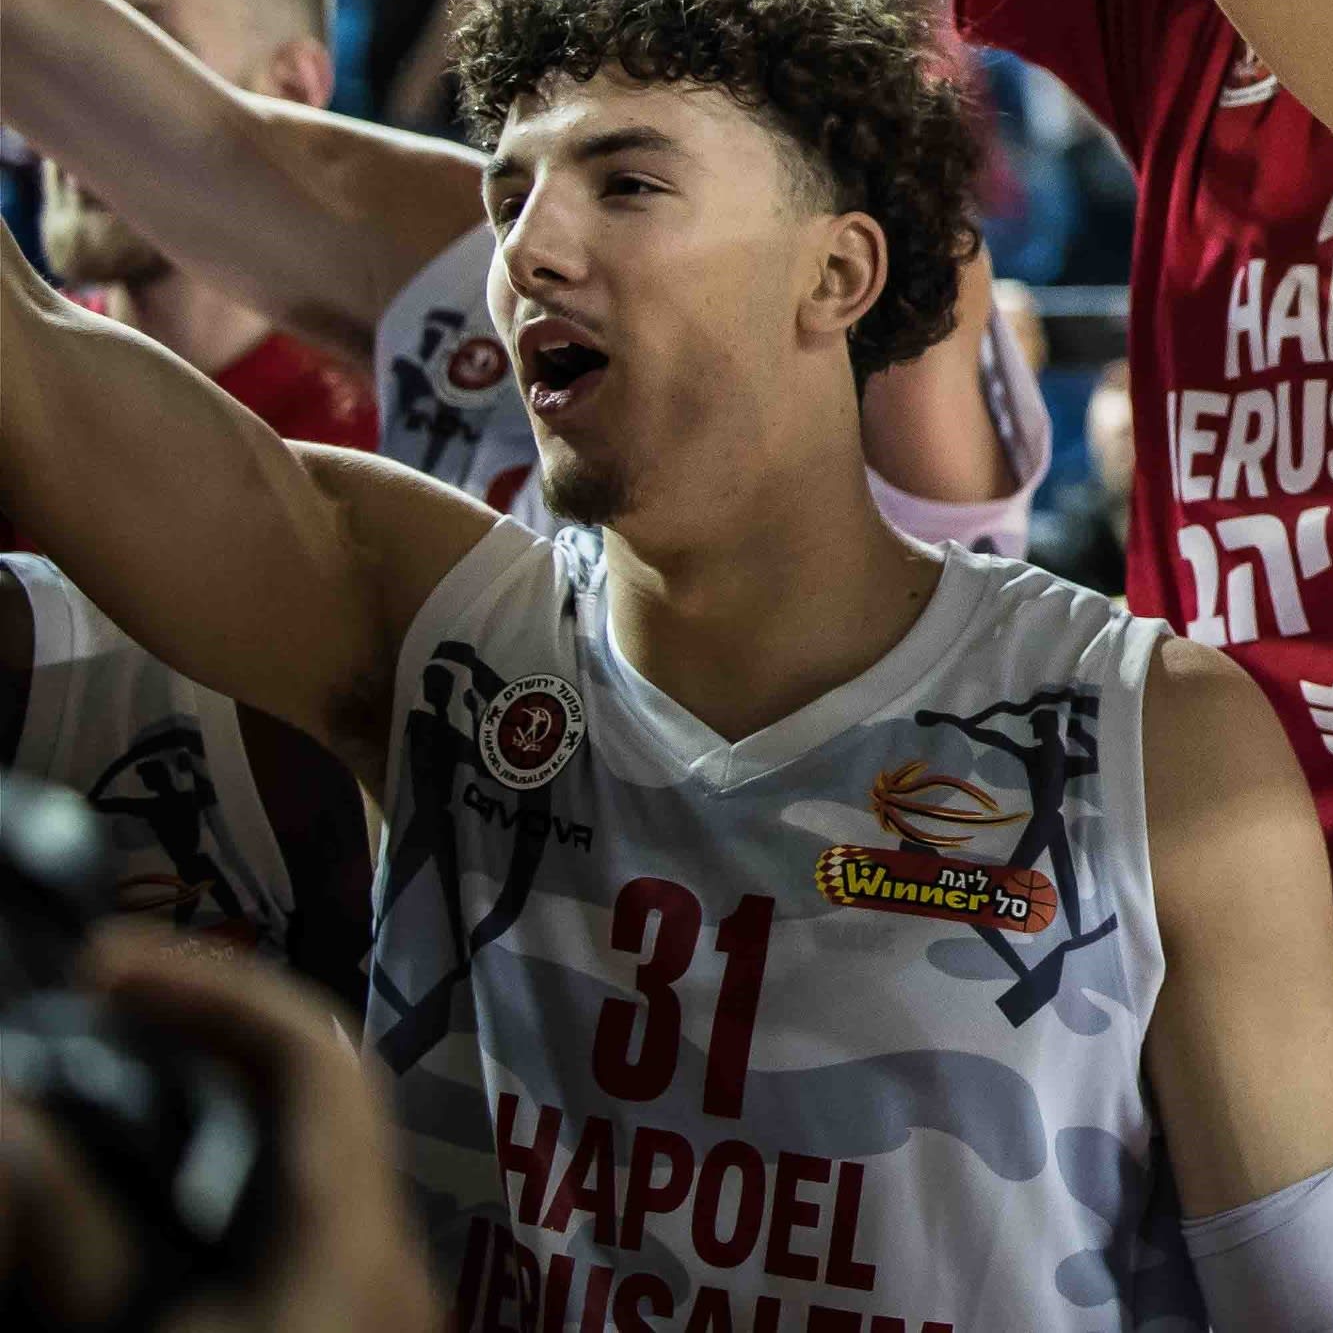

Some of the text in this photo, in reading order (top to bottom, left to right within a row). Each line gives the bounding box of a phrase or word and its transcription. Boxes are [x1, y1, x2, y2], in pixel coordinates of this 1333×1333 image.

[938, 869, 989, 891] ליגת
[995, 890, 1027, 918] סל
[592, 876, 776, 1119] 31
[497, 1092, 876, 1292] HAPOEL
